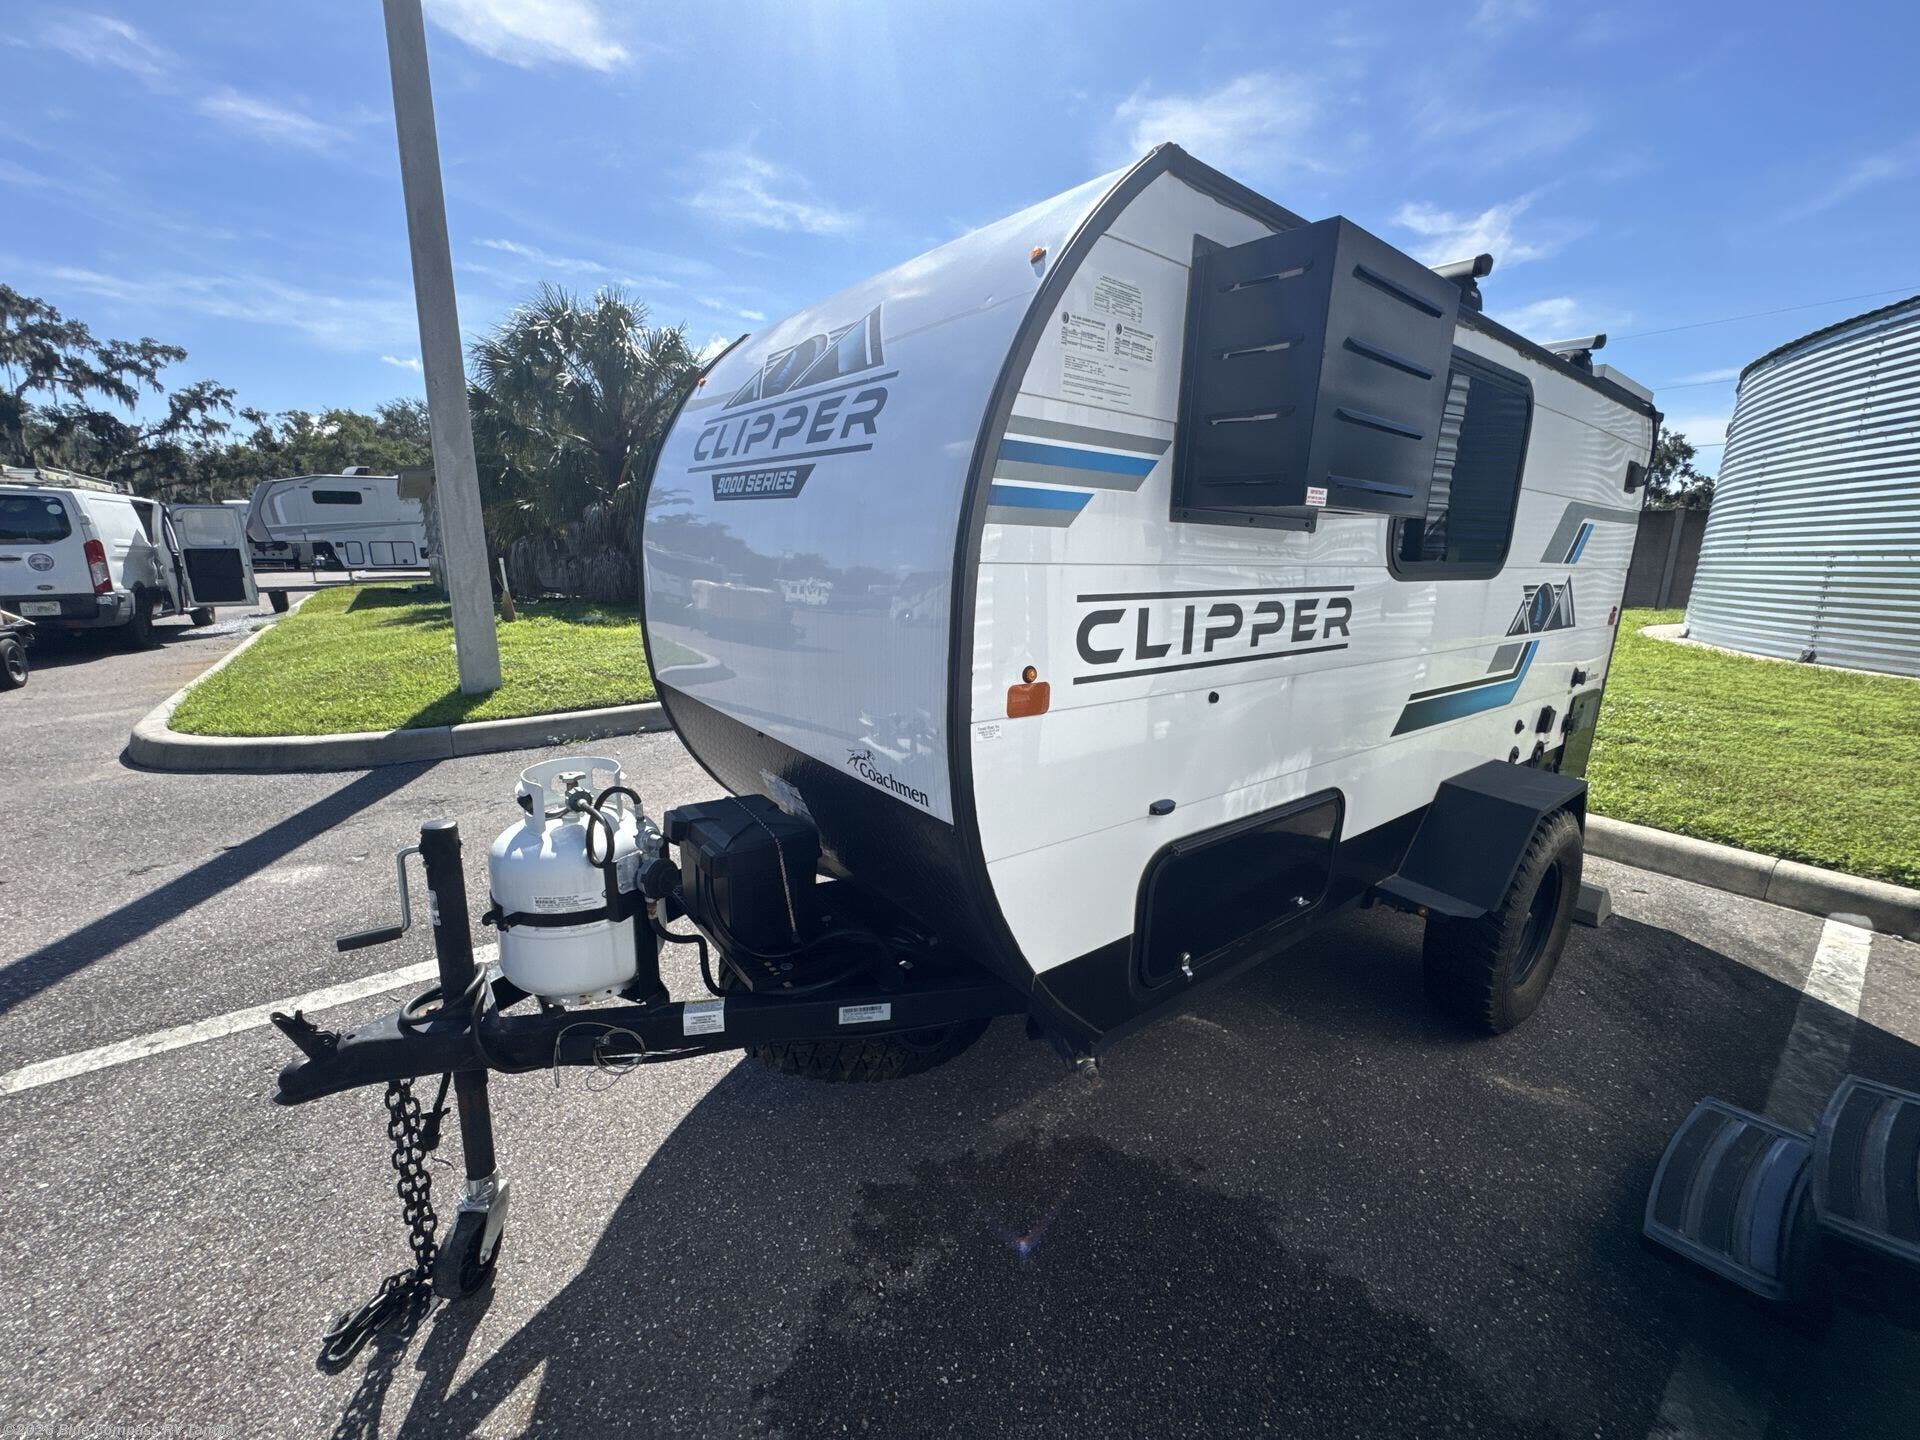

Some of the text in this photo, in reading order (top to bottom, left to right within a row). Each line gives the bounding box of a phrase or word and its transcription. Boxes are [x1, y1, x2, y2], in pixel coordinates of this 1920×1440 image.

[693, 386, 888, 462] CLIPPER
[716, 470, 797, 494] 9000 SERIES
[1076, 597, 1352, 665] CLIPPER
[859, 762, 930, 807] Coachmen
